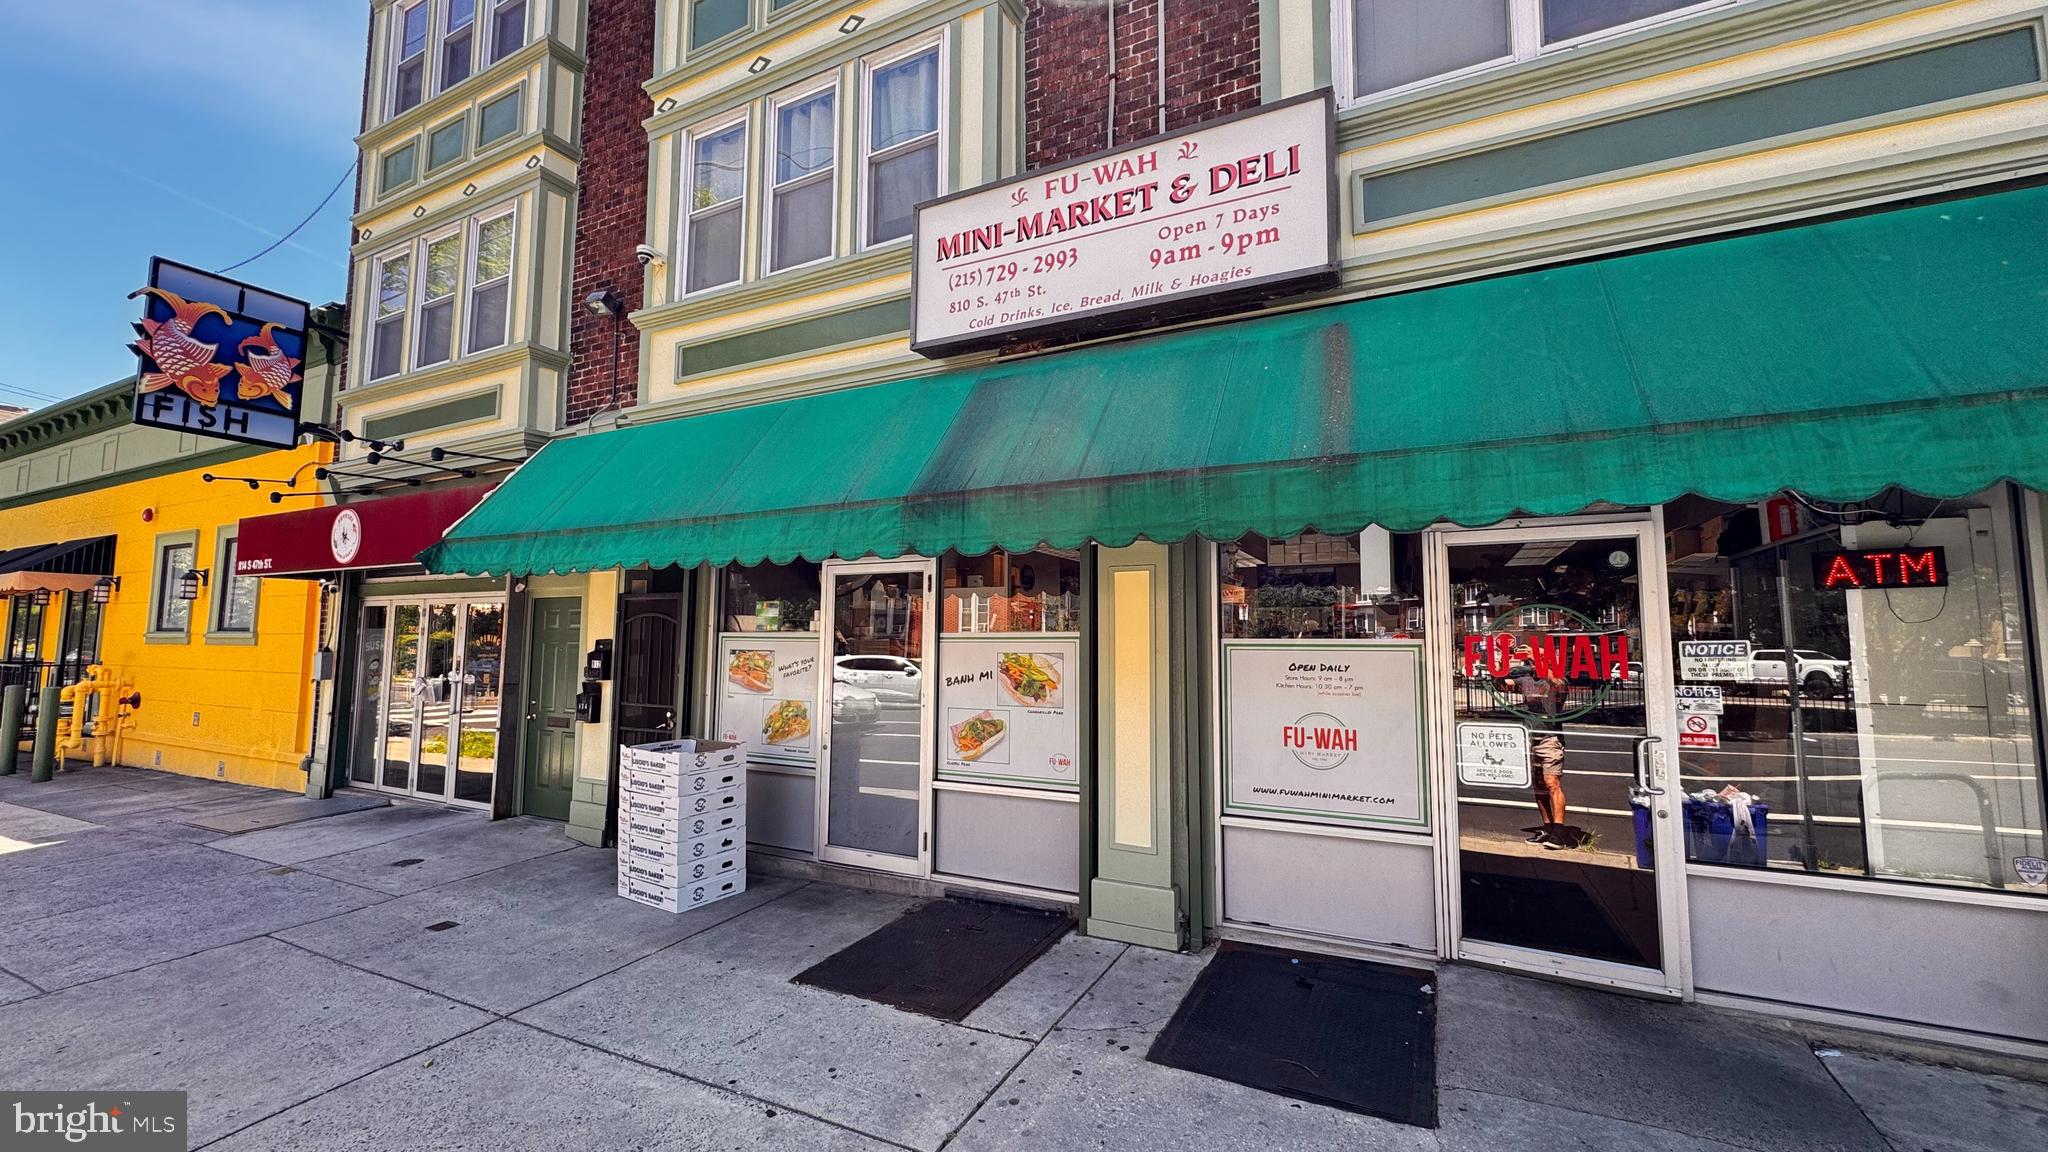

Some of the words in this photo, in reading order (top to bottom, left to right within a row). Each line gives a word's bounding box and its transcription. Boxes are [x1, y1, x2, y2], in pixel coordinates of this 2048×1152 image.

[1045, 150, 1158, 200] FU-WAH
[936, 181, 1158, 262] MINI-MARKET
[1169, 173, 1199, 203] &
[1208, 143, 1301, 196] DELI
[1158, 220, 1206, 241] Open
[1216, 213, 1225, 229] 7
[1233, 203, 1280, 224] Days
[1033, 247, 1078, 275] 2993
[949, 299, 970, 314] 810
[976, 296, 988, 308] S.
[994, 289, 1021, 305] 47th
[1027, 285, 1046, 297] St.
[969, 315, 994, 329] Cold
[1131, 280, 1163, 299] Milk
[1170, 278, 1182, 290] &
[1189, 266, 1252, 287] Hoagies
[153, 394, 249, 434] FISH
[1824, 551, 1938, 587] ATM
[778, 660, 800, 672] WHAT'S
[800, 656, 815, 667] YOUR
[1463, 634, 1629, 680] FU-WAH
[1684, 643, 1746, 657] NOTICE
[783, 664, 812, 679] FAVORITE?
[945, 674, 975, 687] BANH
[979, 670, 993, 682] MI
[1675, 687, 1720, 697] NOTICE
[1283, 726, 1358, 751] FU-WAH
[1470, 740, 1517, 748] ALLOWED
[1049, 757, 1071, 767] FU-WAH
